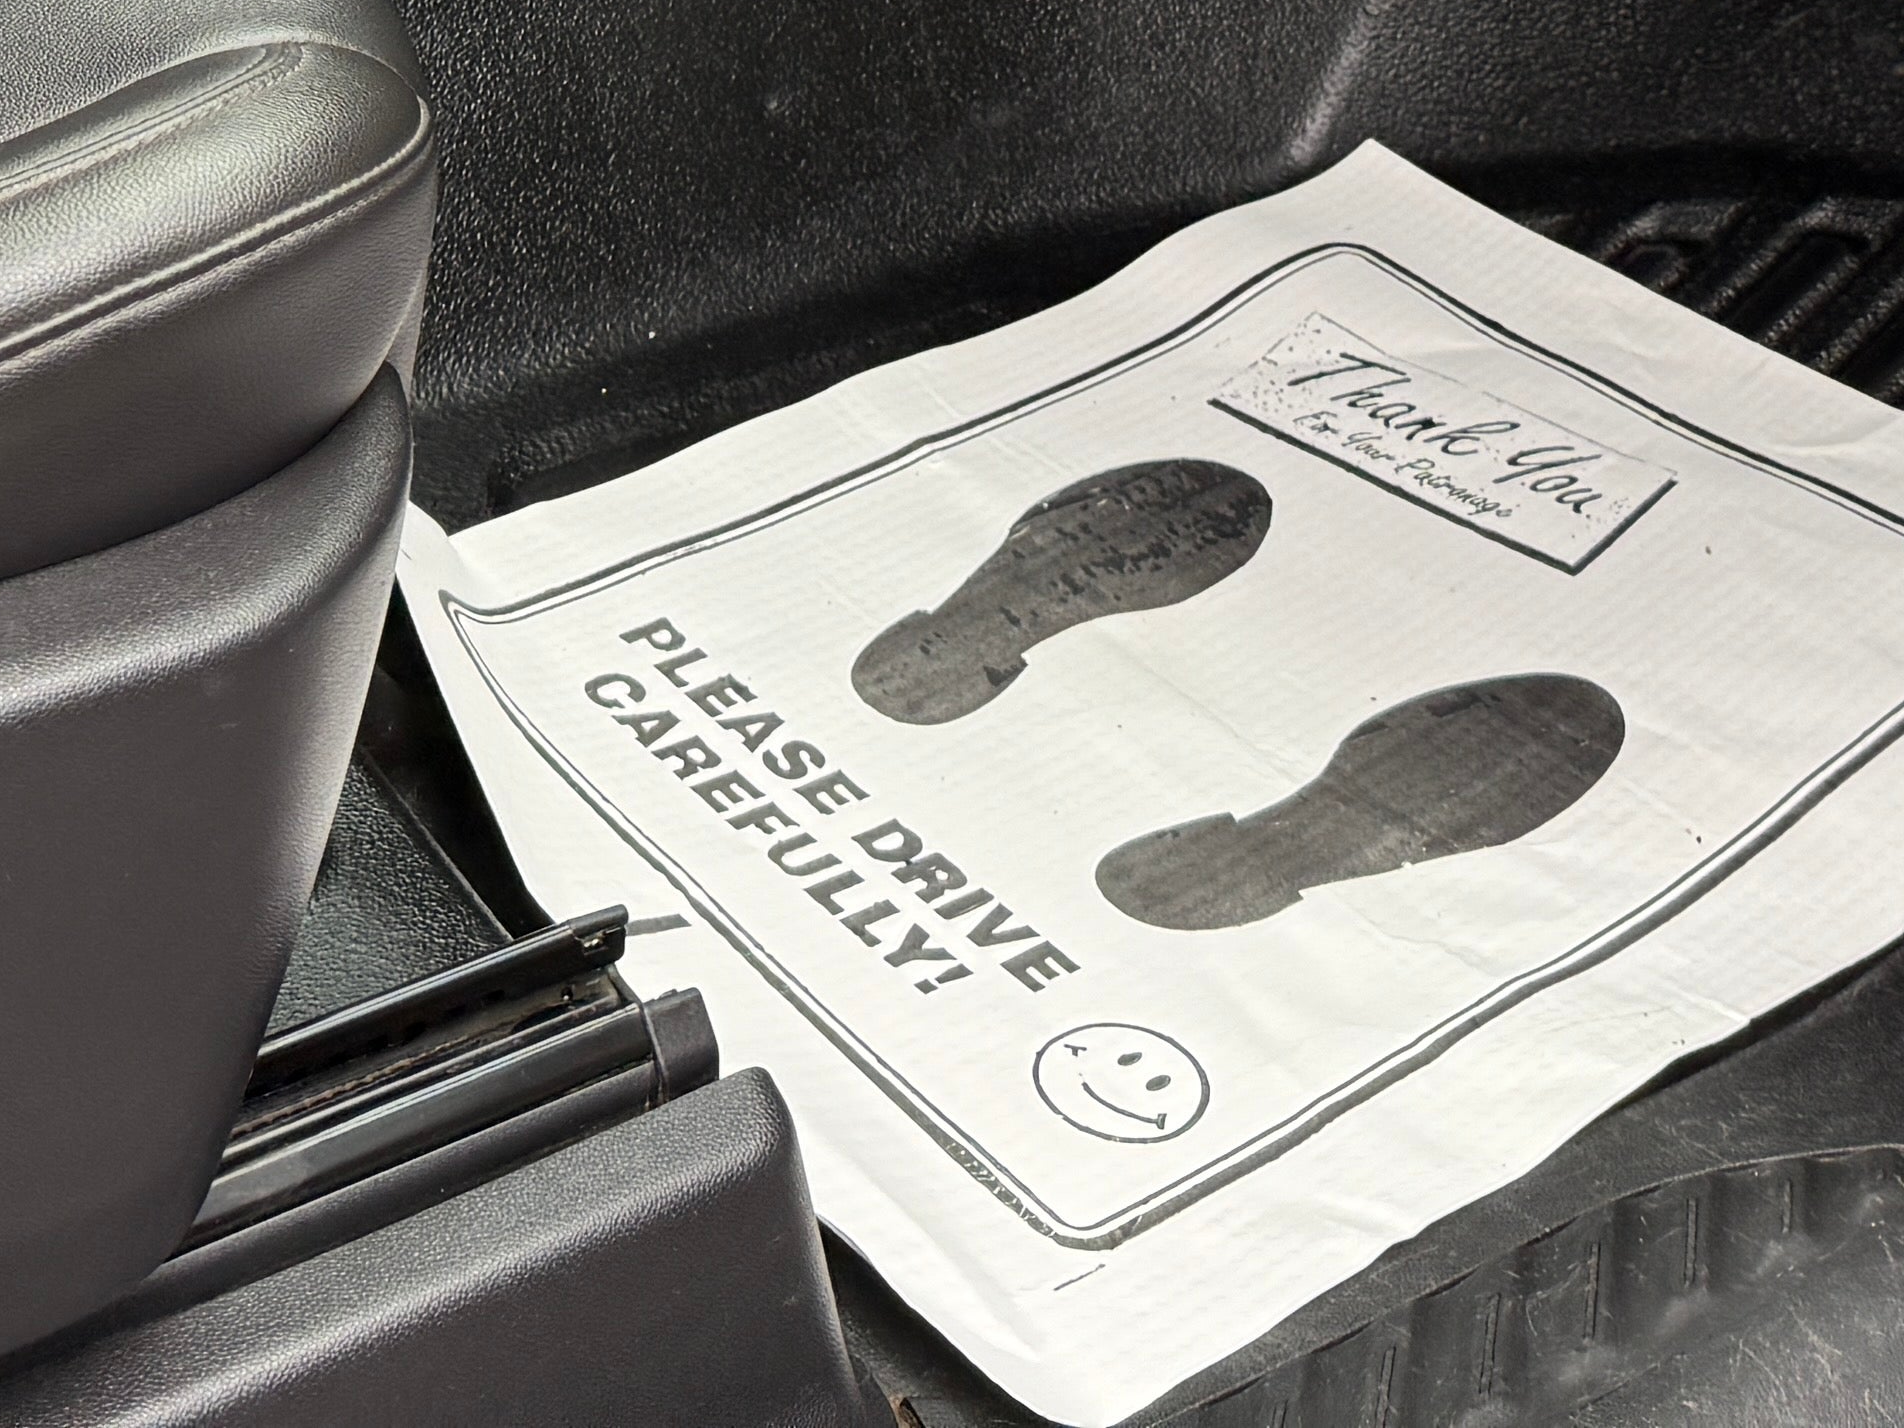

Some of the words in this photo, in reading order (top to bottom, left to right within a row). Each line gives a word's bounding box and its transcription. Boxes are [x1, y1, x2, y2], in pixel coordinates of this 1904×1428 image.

[1287, 352, 1521, 456] Thank
[1493, 446, 1603, 515] You
[584, 673, 975, 995] CAREFULLY!
[618, 617, 871, 816] PLEASE
[851, 818, 1082, 994] DRIVE
